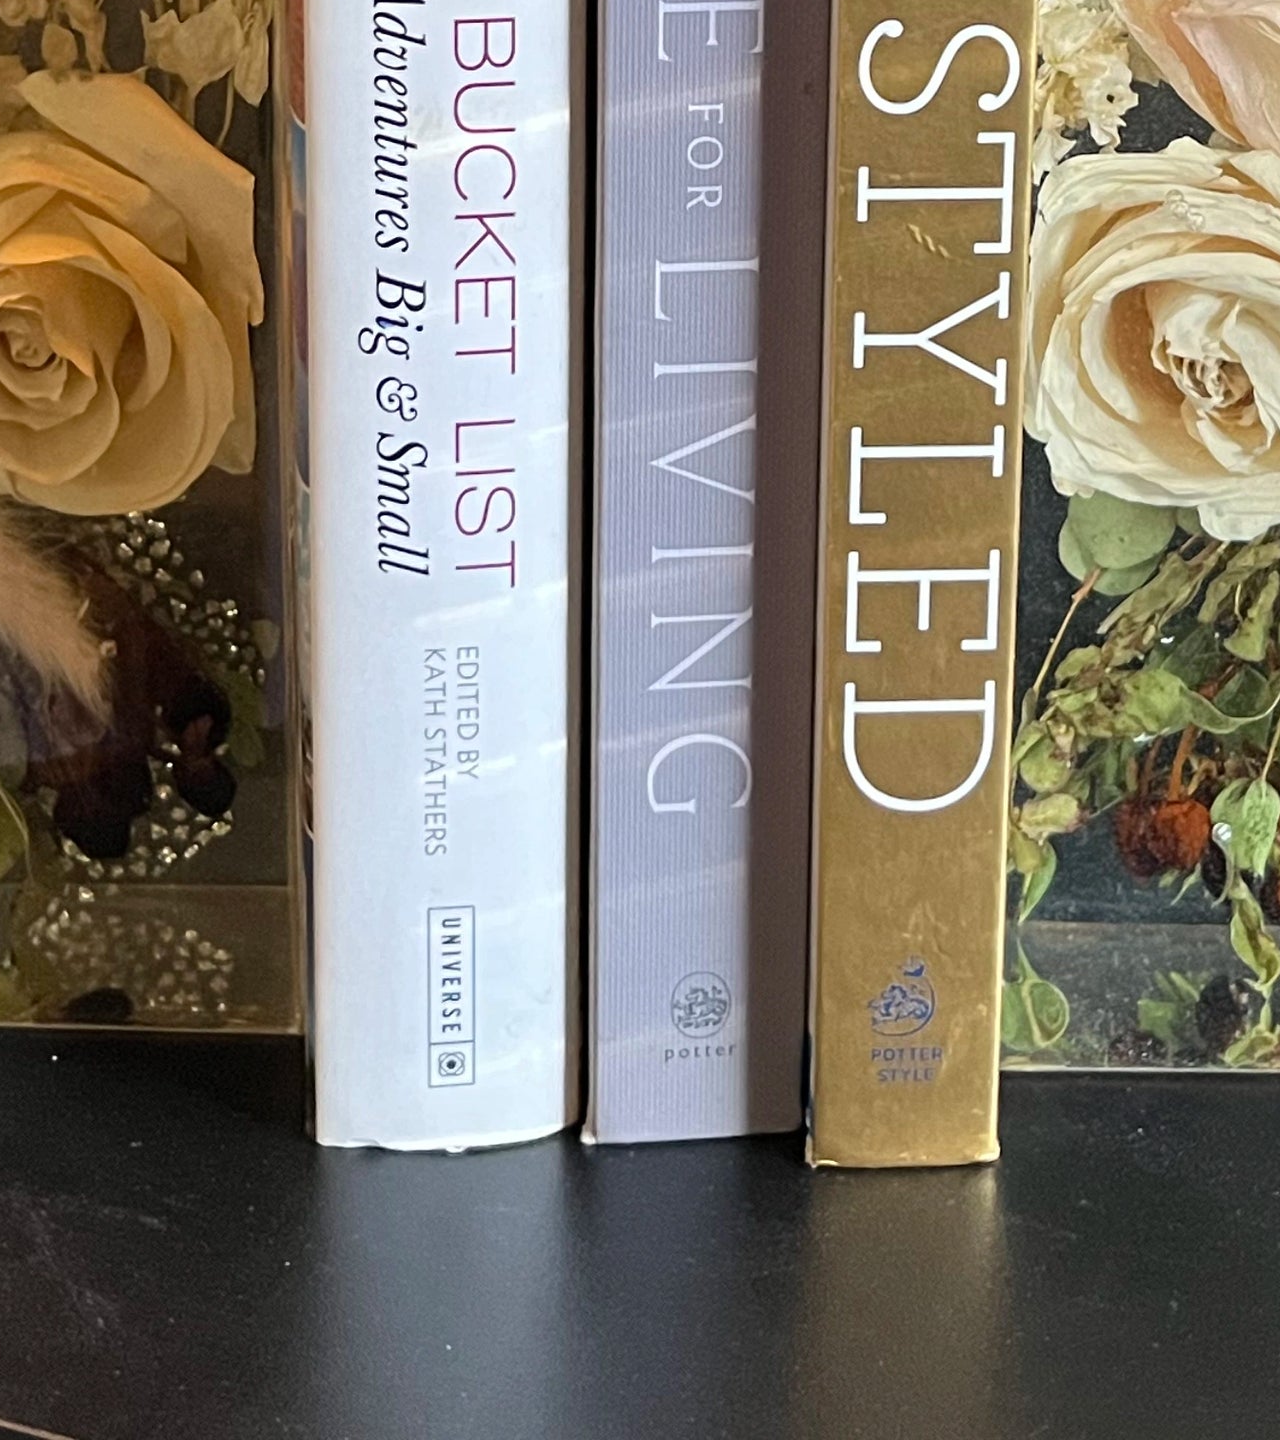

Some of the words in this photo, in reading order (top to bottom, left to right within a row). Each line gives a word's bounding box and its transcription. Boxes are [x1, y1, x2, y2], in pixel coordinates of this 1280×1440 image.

[452, 17, 518, 375] BUCKET
[685, 102, 725, 210] FOR
[357, 268, 428, 361] Big
[374, 376, 419, 424] &
[842, 18, 1022, 813] STYLED
[375, 432, 431, 577] Small
[452, 418, 518, 589] LIST
[646, 256, 761, 815] LIVING
[422, 647, 447, 721] KATH
[455, 644, 480, 743] EDITED
[423, 727, 448, 858] STATHERS
[455, 749, 480, 781] BY
[440, 917, 463, 1034] UNIVERSE
[663, 1040, 738, 1063] potter
[870, 1046, 945, 1065] POTTER
[876, 1066, 936, 1084] STYLE
